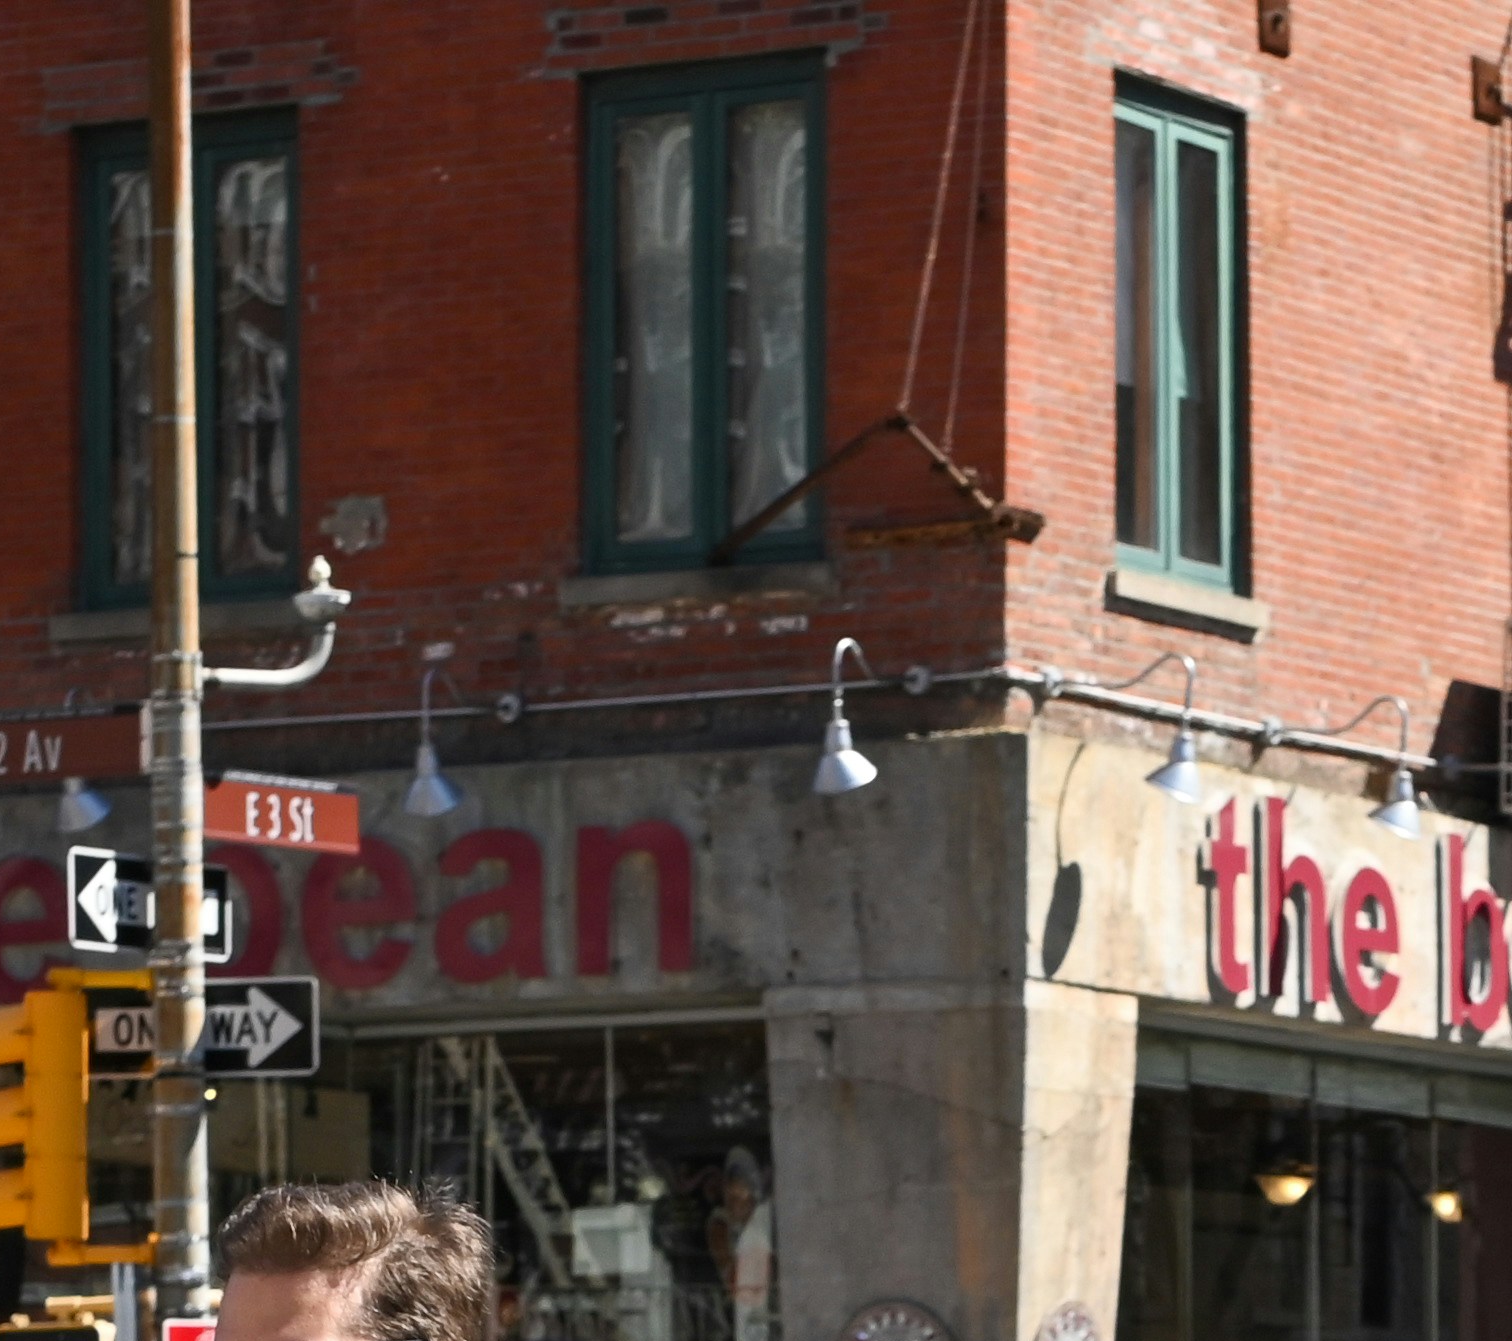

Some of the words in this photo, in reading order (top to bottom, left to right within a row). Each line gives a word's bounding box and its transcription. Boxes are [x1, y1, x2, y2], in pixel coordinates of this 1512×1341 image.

[22, 729, 63, 774] Av
[245, 791, 260, 838] E
[267, 795, 282, 840] 3
[289, 795, 315, 844] St
[1205, 794, 1401, 1017] the
[113, 1013, 154, 1047] ON
[208, 1010, 279, 1045] WAY
